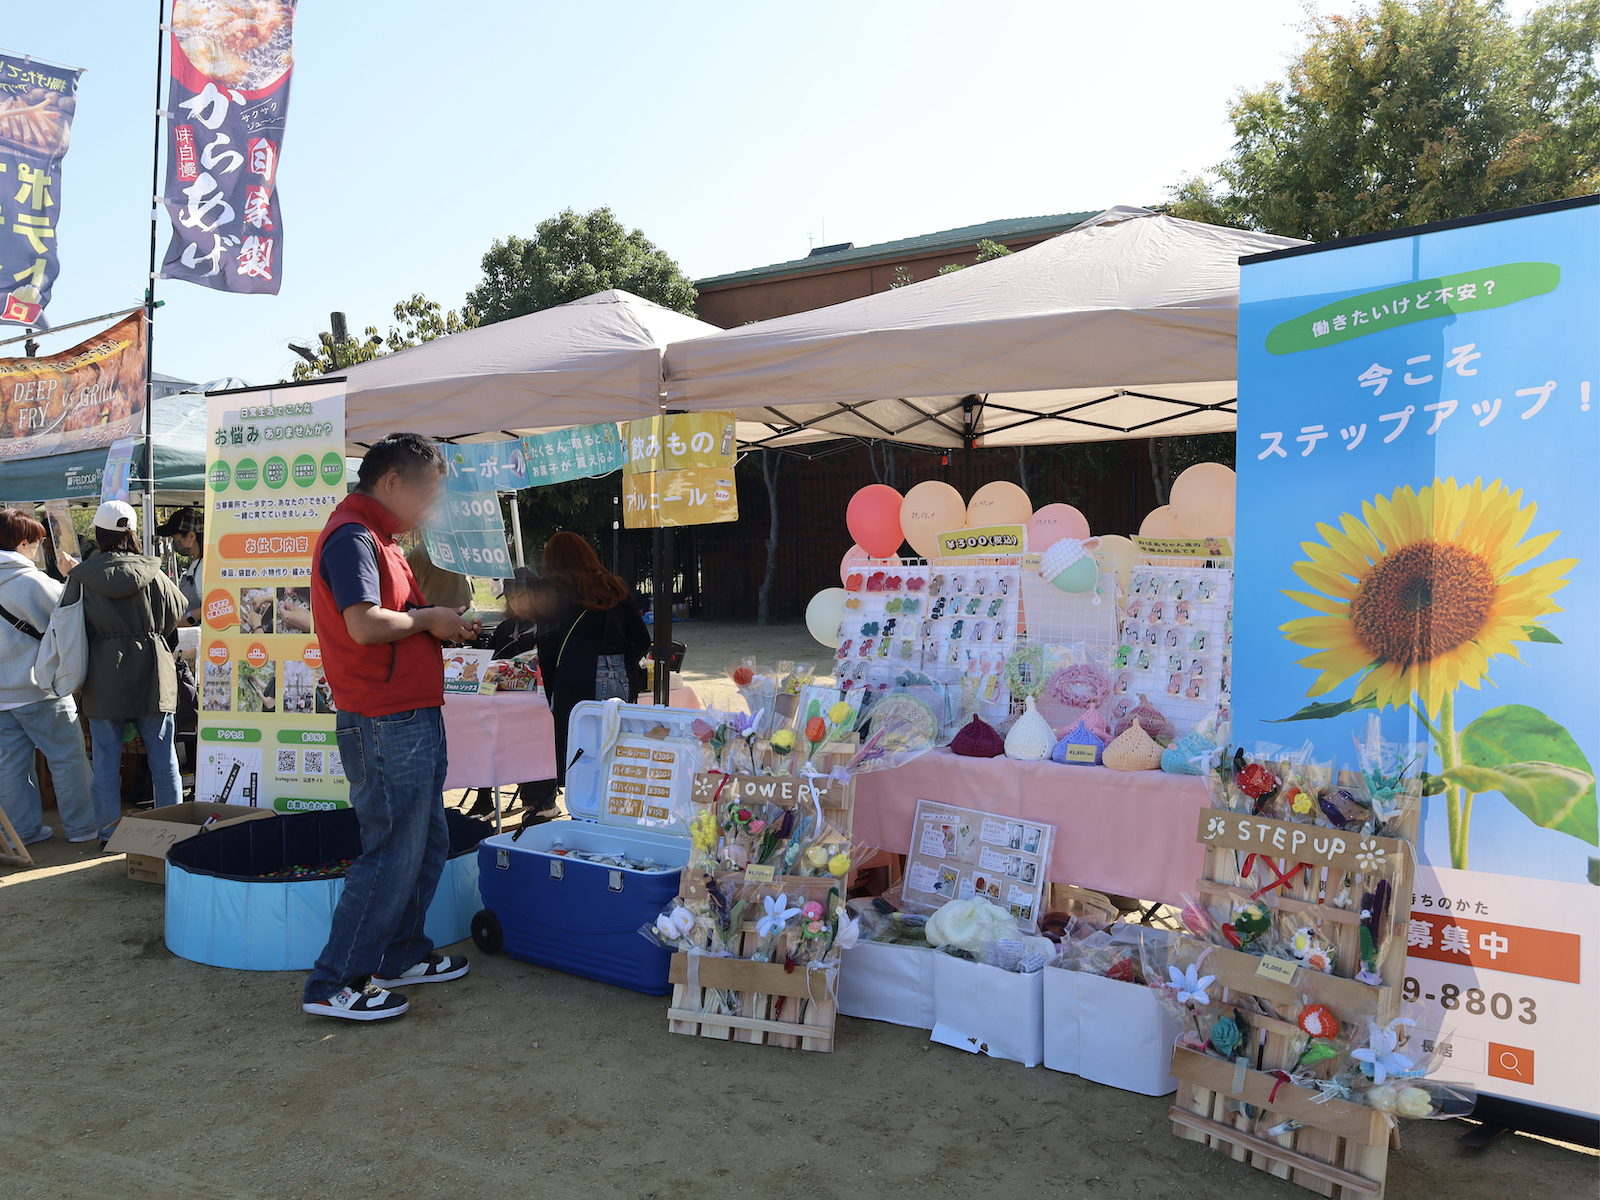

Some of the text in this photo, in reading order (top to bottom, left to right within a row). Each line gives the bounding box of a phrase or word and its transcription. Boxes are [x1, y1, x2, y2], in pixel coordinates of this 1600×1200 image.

[242, 102, 276, 122] サクサク
[247, 117, 284, 130] ジューシー
[175, 127, 198, 178] 味自慢
[178, 82, 247, 278] からあげ
[236, 137, 274, 280] 自家製
[1312, 280, 1496, 338] 働きたいけど不安？
[1358, 342, 1482, 396] 今こそ
[14, 378, 58, 404] DEEP
[80, 378, 117, 407] GRILL
[18, 401, 50, 430] FRY
[241, 402, 312, 419] 日常生活でこんな
[1257, 380, 1590, 460] ステップアップ！
[214, 426, 260, 446] お悩み
[632, 431, 714, 462] 飲みもの
[450, 499, 496, 517] ¥300
[626, 488, 708, 512] アルコール
[234, 508, 318, 519] 一緒に育てていきましょう。
[245, 536, 308, 553] お仕事内容
[946, 535, 1018, 550] ¥300(税込)
[460, 546, 506, 564] ¥500
[217, 730, 245, 739] アクセス
[614, 767, 642, 775] ハイボール
[718, 777, 810, 802] FLOWER
[1238, 820, 1346, 860] STEP UP
[1408, 918, 1509, 960] 募集中
[338, 995, 346, 1004] 66
[1402, 976, 1537, 1025] 9-8803
